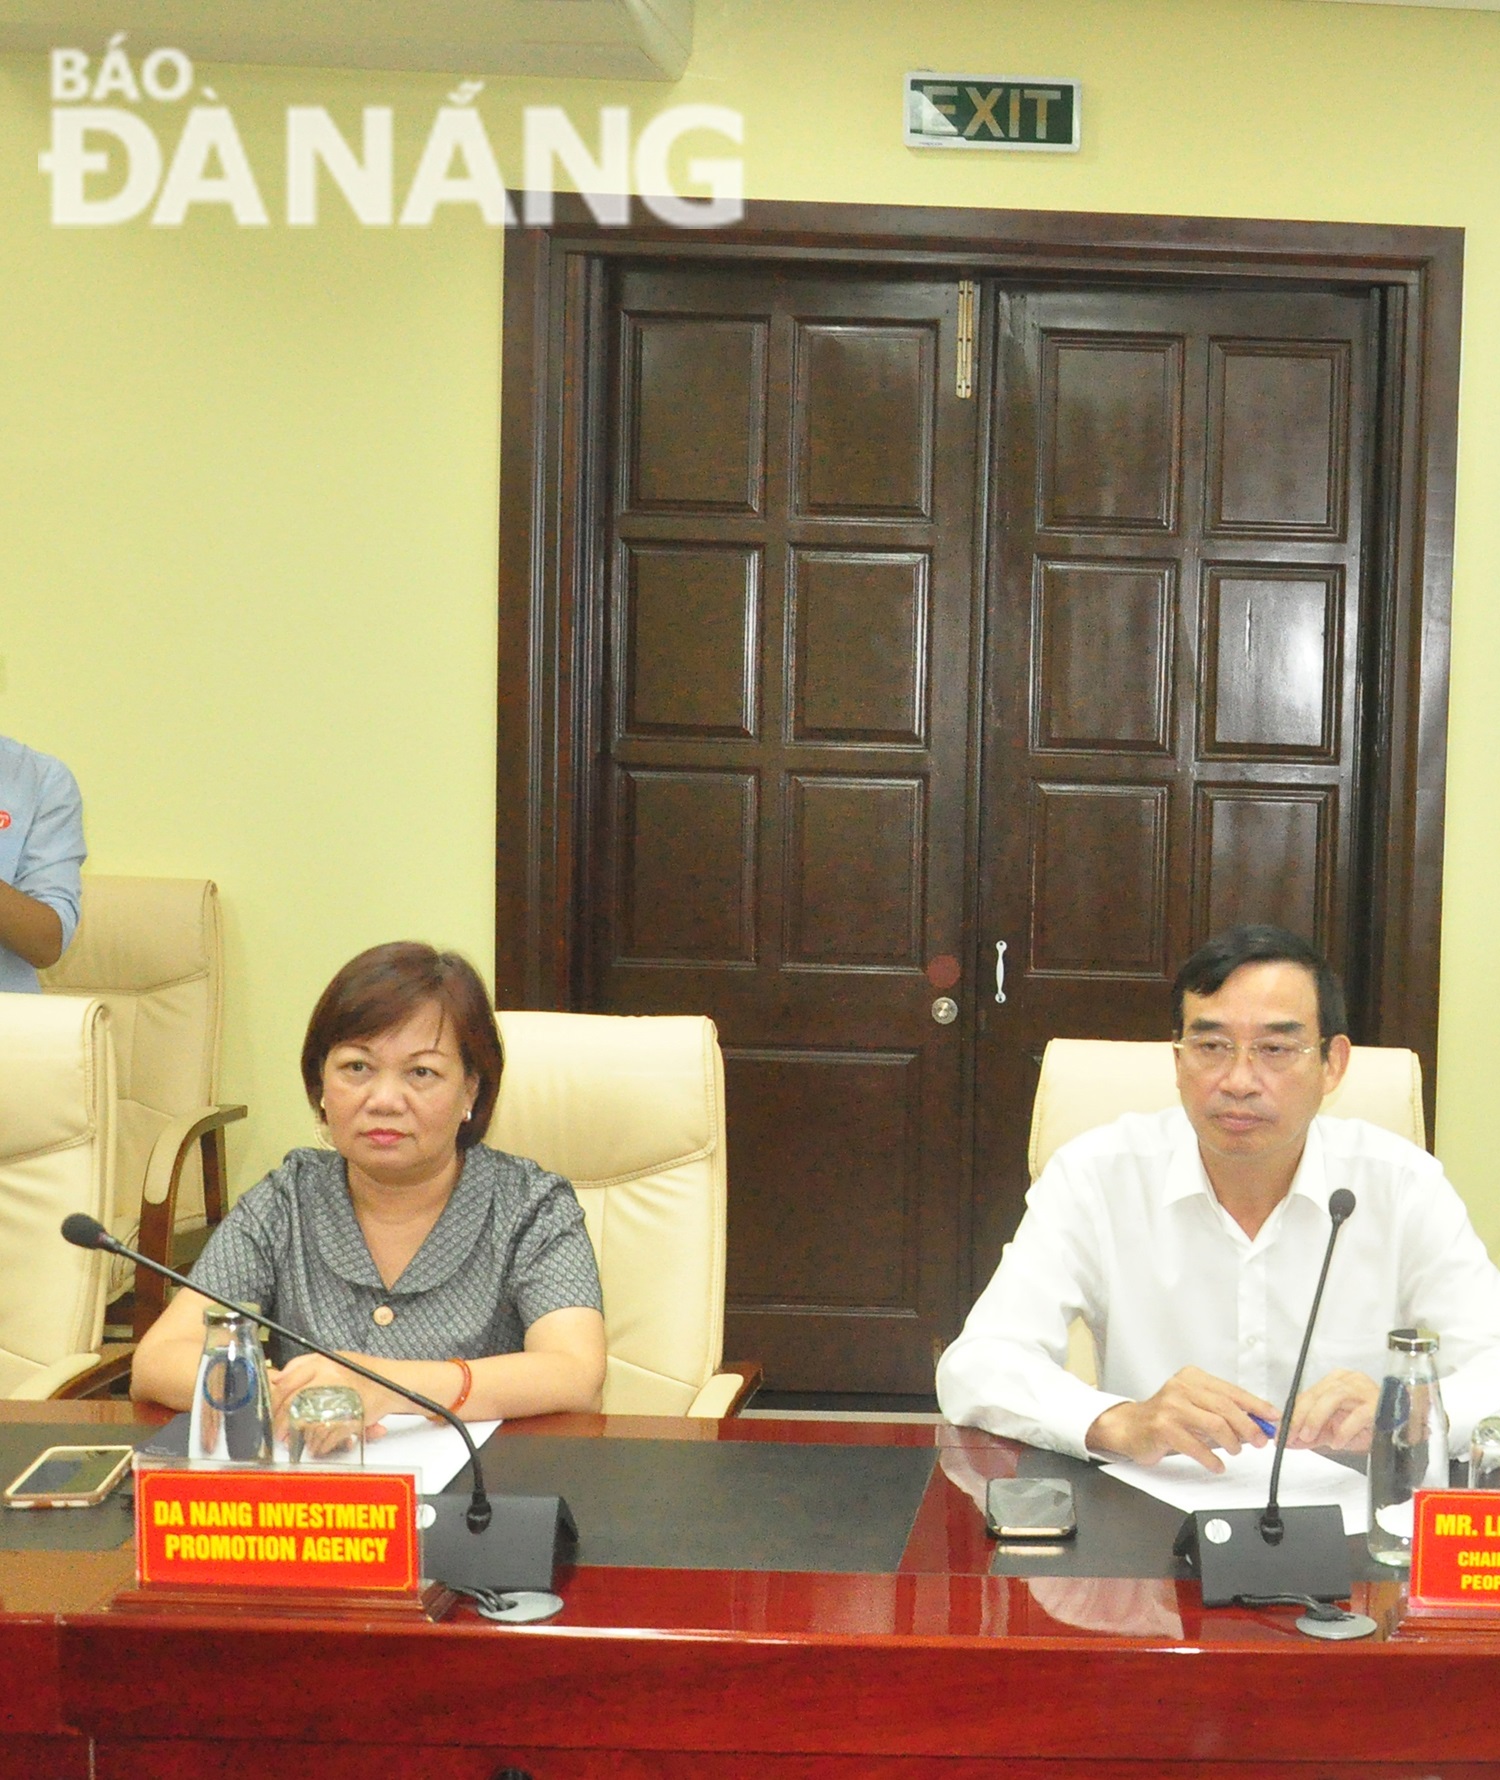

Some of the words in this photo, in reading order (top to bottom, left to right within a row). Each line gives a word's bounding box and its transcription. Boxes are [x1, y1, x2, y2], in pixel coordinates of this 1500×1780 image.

[921, 86, 1061, 139] EXIT
[153, 1500, 185, 1527] DA
[189, 1501, 253, 1528] NANG
[258, 1502, 399, 1530] INVESTMENT
[1434, 1513, 1479, 1537] MR.
[165, 1533, 297, 1562] PROMOTION
[301, 1536, 388, 1563] AGENCY
